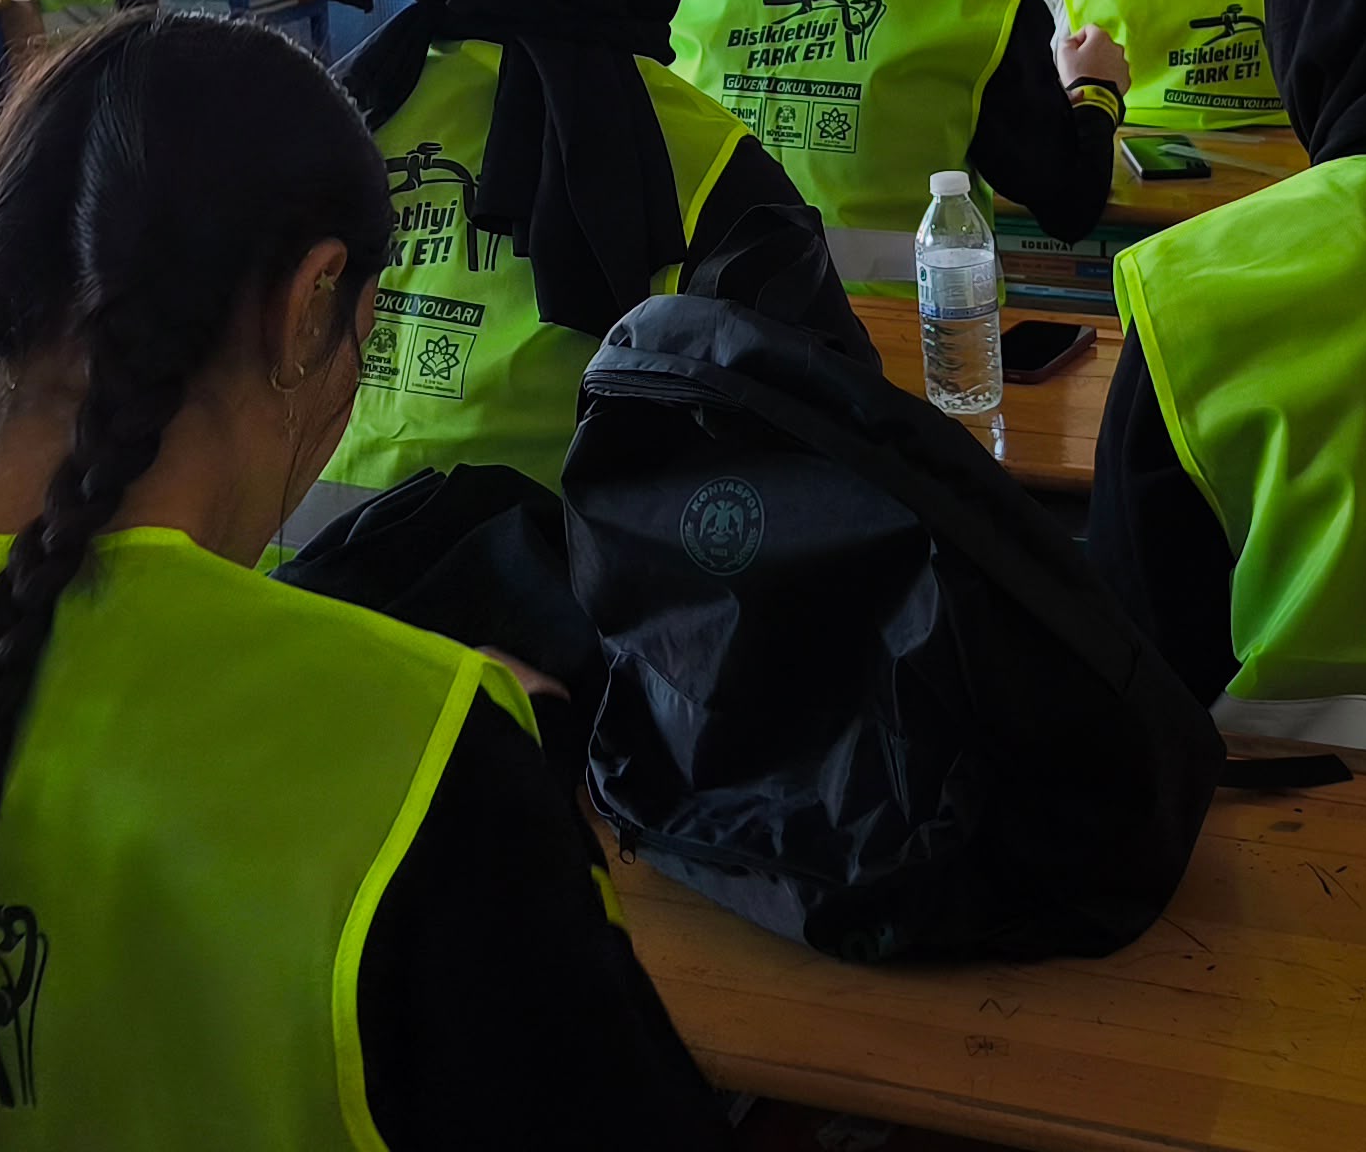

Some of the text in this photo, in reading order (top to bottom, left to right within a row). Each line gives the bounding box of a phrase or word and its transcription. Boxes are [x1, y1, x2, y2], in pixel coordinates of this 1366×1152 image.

[728, 18, 838, 47] Bisikletliyi
[747, 40, 836, 69] FARK ET!
[1168, 40, 1260, 67] Bisikletliyi
[726, 76, 858, 98] GÜVENLİ OKUL YOLLARI
[1185, 62, 1261, 86] FARK ET!
[1166, 91, 1211, 105] GÜVENLİ
[1212, 95, 1240, 107] OKUL
[412, 236, 453, 266] ET!
[412, 300, 479, 323] YOLLARI
[691, 481, 759, 520] KONYASPOR
